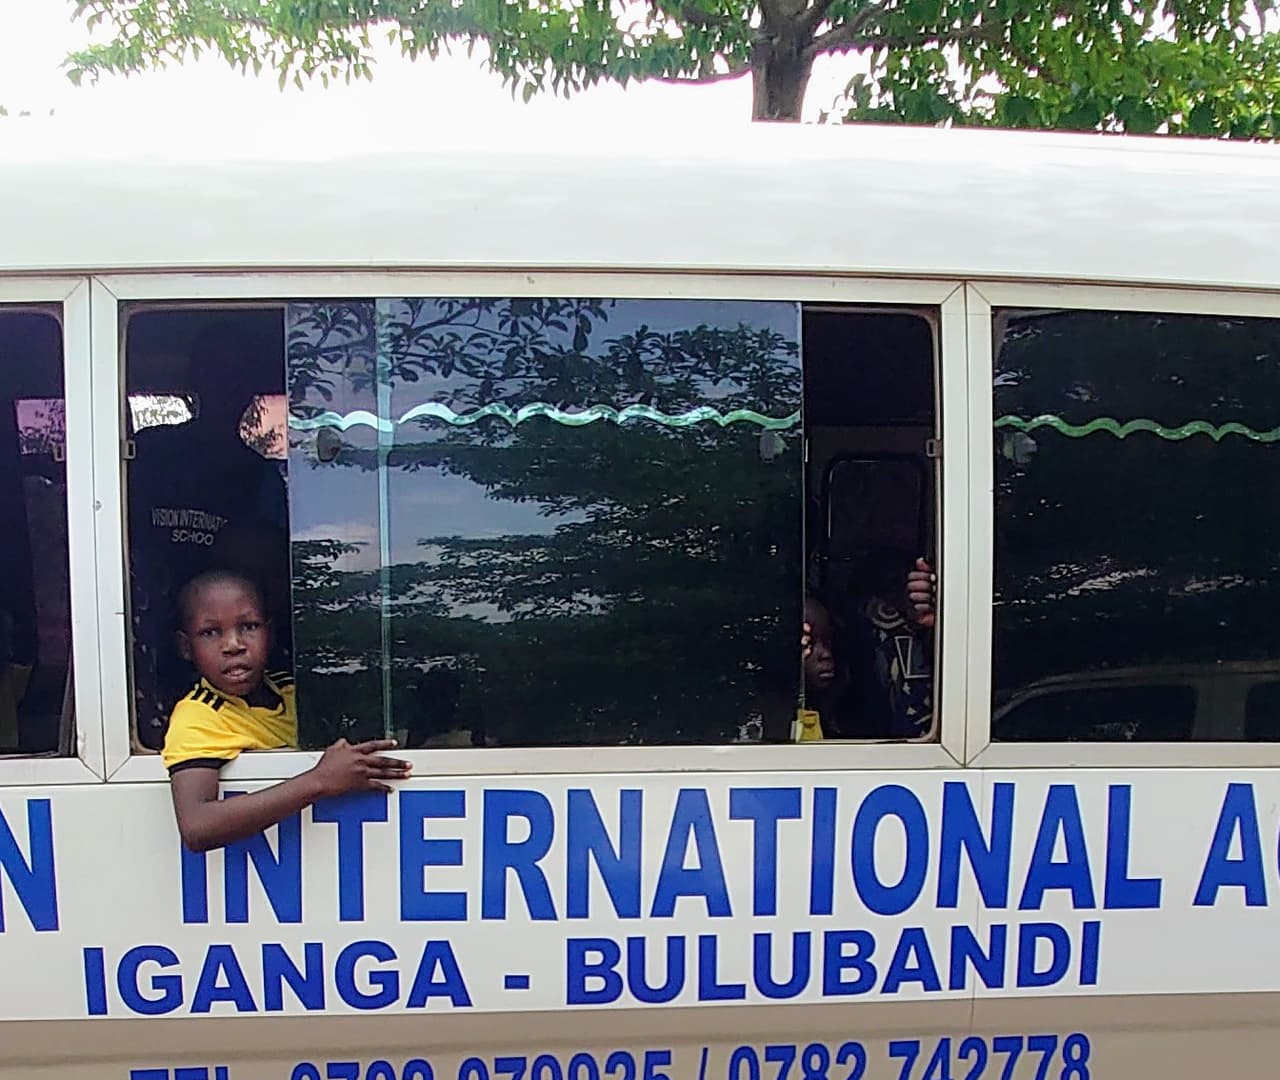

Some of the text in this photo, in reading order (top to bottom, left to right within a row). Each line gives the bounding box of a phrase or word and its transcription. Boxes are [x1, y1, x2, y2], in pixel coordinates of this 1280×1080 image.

[179, 780, 1164, 924] INTERNATIONAL
[82, 919, 1103, 1016] IGANGA - BULUBANDI
